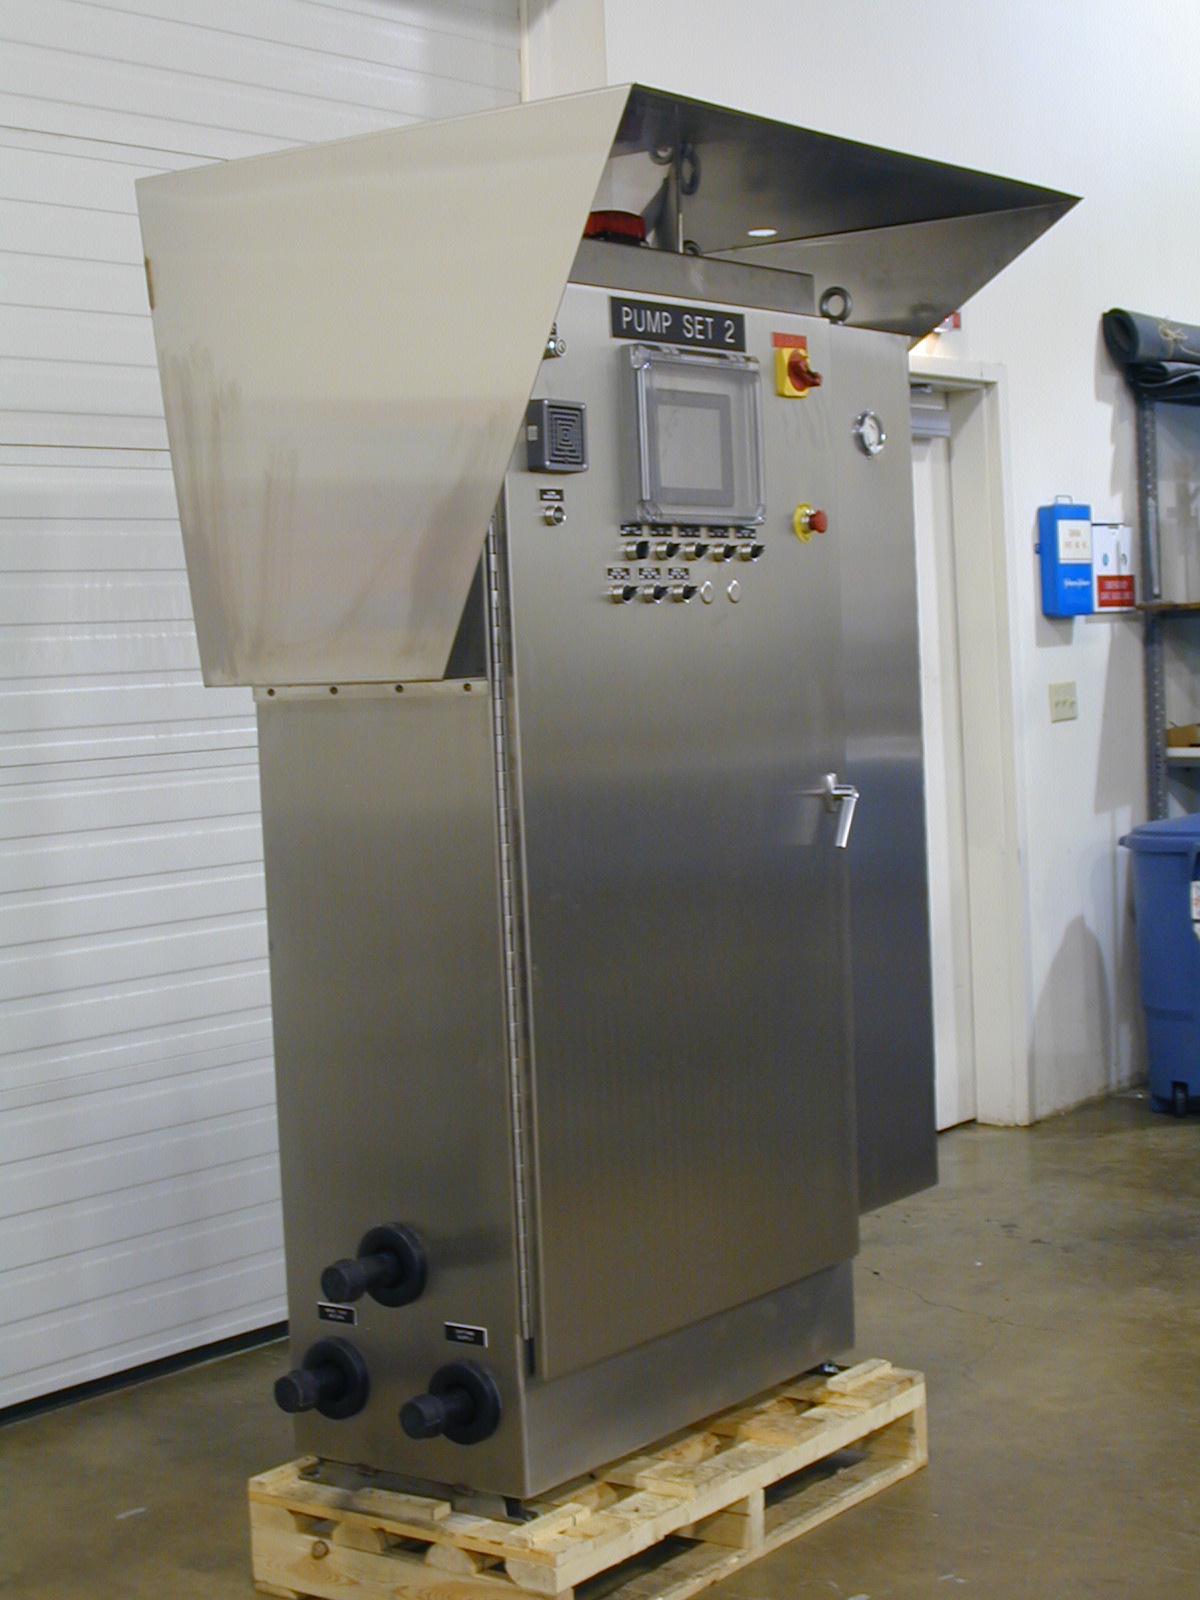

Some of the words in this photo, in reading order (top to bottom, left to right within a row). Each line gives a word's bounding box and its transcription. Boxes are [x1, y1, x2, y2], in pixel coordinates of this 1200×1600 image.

[621, 306, 672, 334] PUMP
[682, 314, 714, 340] SET
[724, 320, 736, 343] 2
